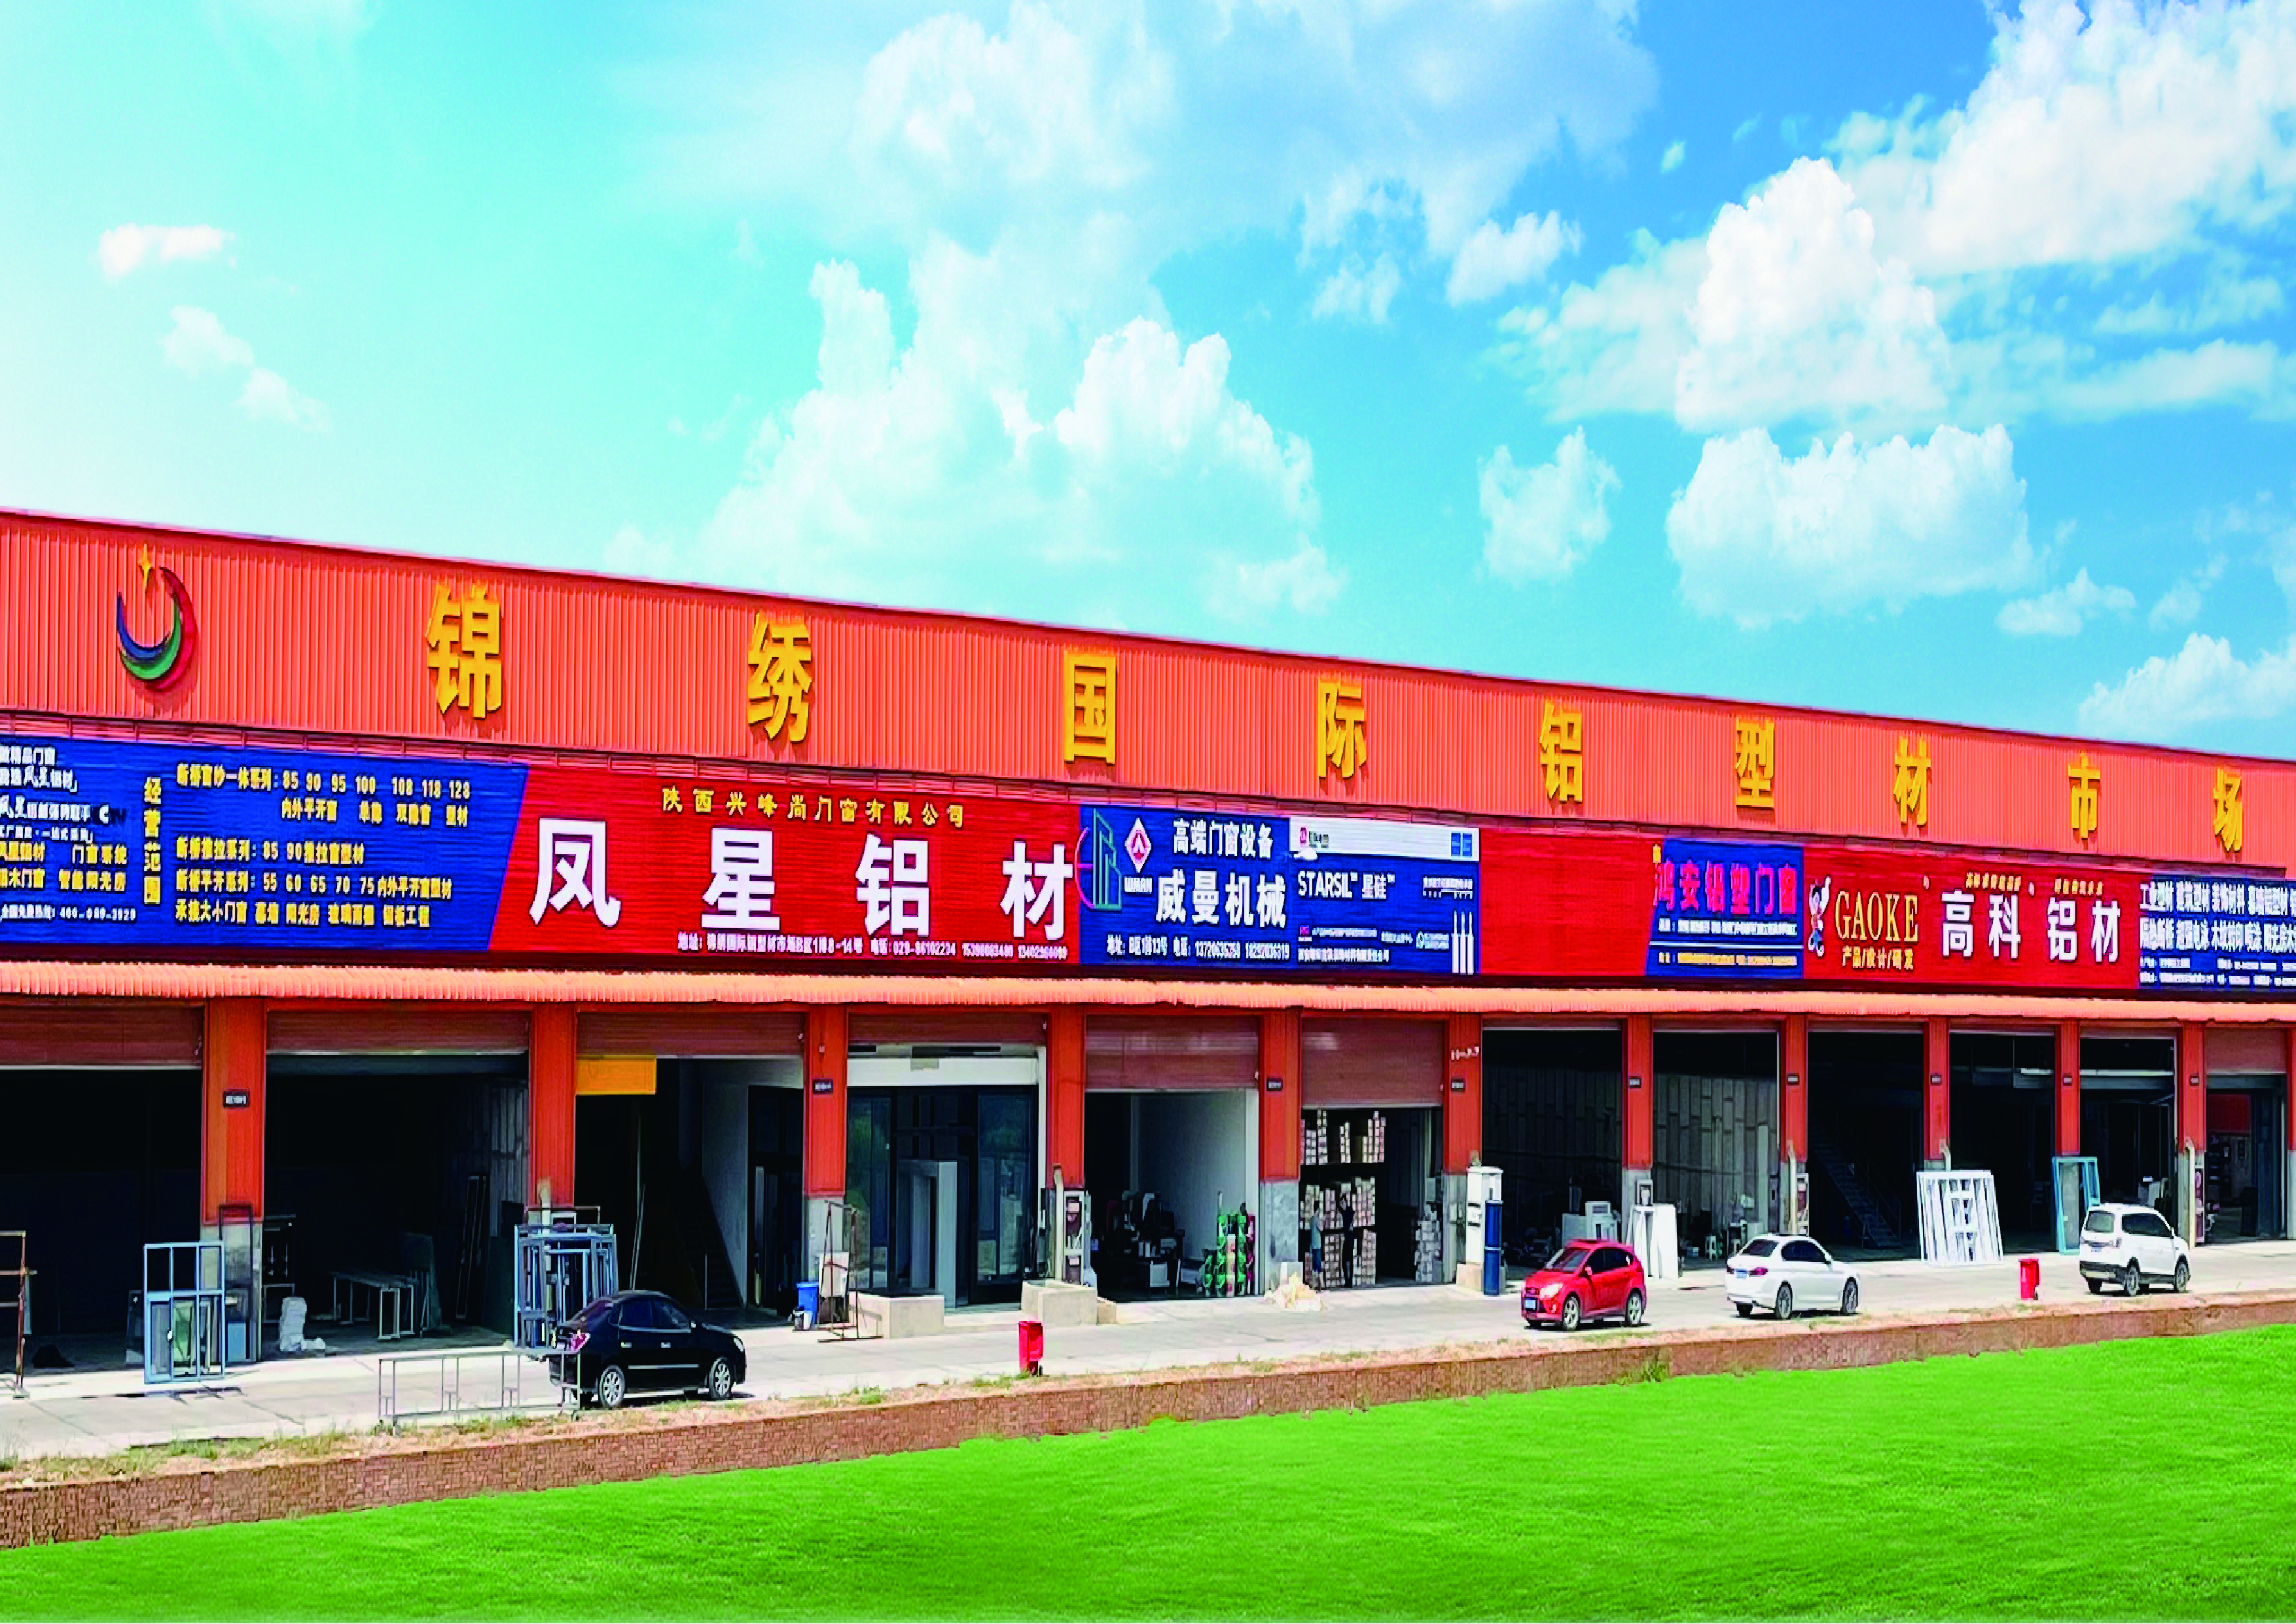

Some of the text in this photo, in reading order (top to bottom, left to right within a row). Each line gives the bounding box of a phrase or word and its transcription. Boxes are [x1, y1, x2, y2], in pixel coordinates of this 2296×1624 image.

[423, 585, 2242, 854] 锦绣国际铝型材市场
[355, 776, 375, 794] 100
[1174, 818, 1273, 857] 高端门窗设备
[530, 818, 1072, 941] 凤星铝材
[1156, 869, 1285, 928] 威曼机械
[1836, 891, 1917, 941] GAOKE
[1942, 886, 2020, 958] 高科
[2048, 897, 2120, 962] 铝材
